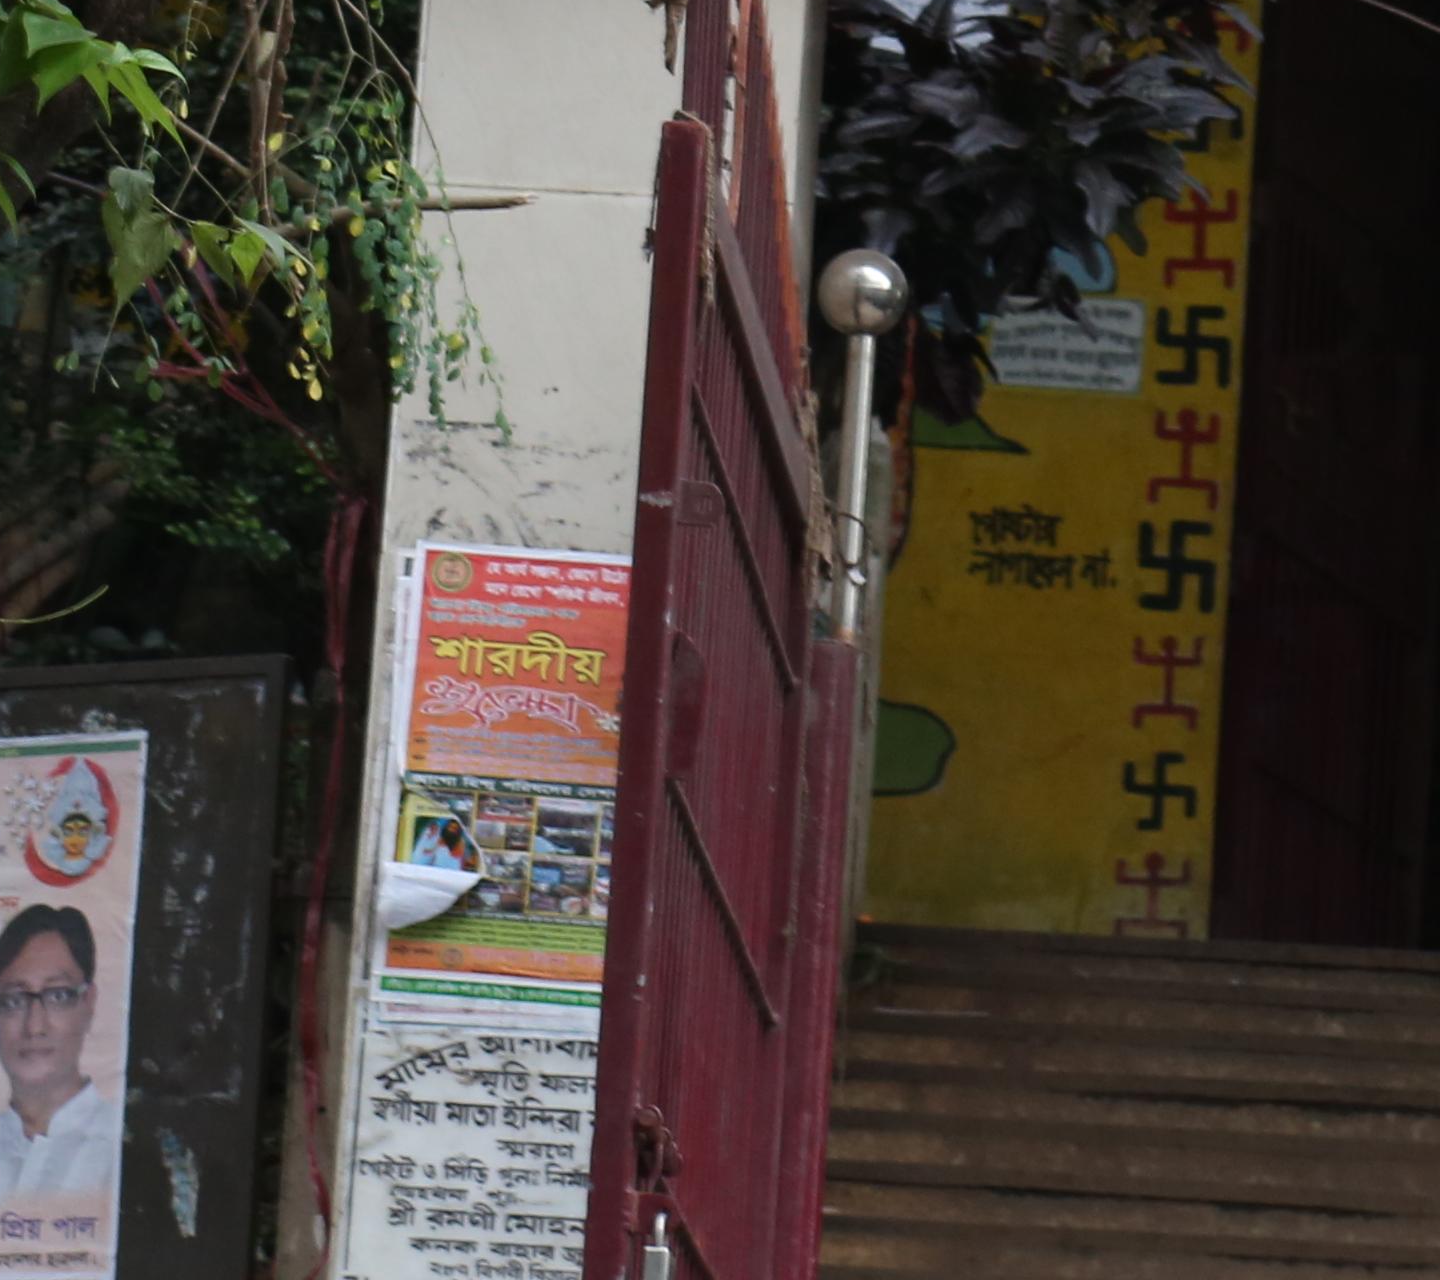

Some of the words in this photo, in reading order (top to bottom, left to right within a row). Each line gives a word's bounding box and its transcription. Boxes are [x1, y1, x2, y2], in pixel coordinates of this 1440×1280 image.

[429, 631, 606, 686] শারদীয়
[375, 1040, 470, 1091] মায়ের
[445, 1100, 497, 1128] মাতা
[51, 1215, 99, 1241] পাল
[386, 1198, 418, 1229] শ্রী
